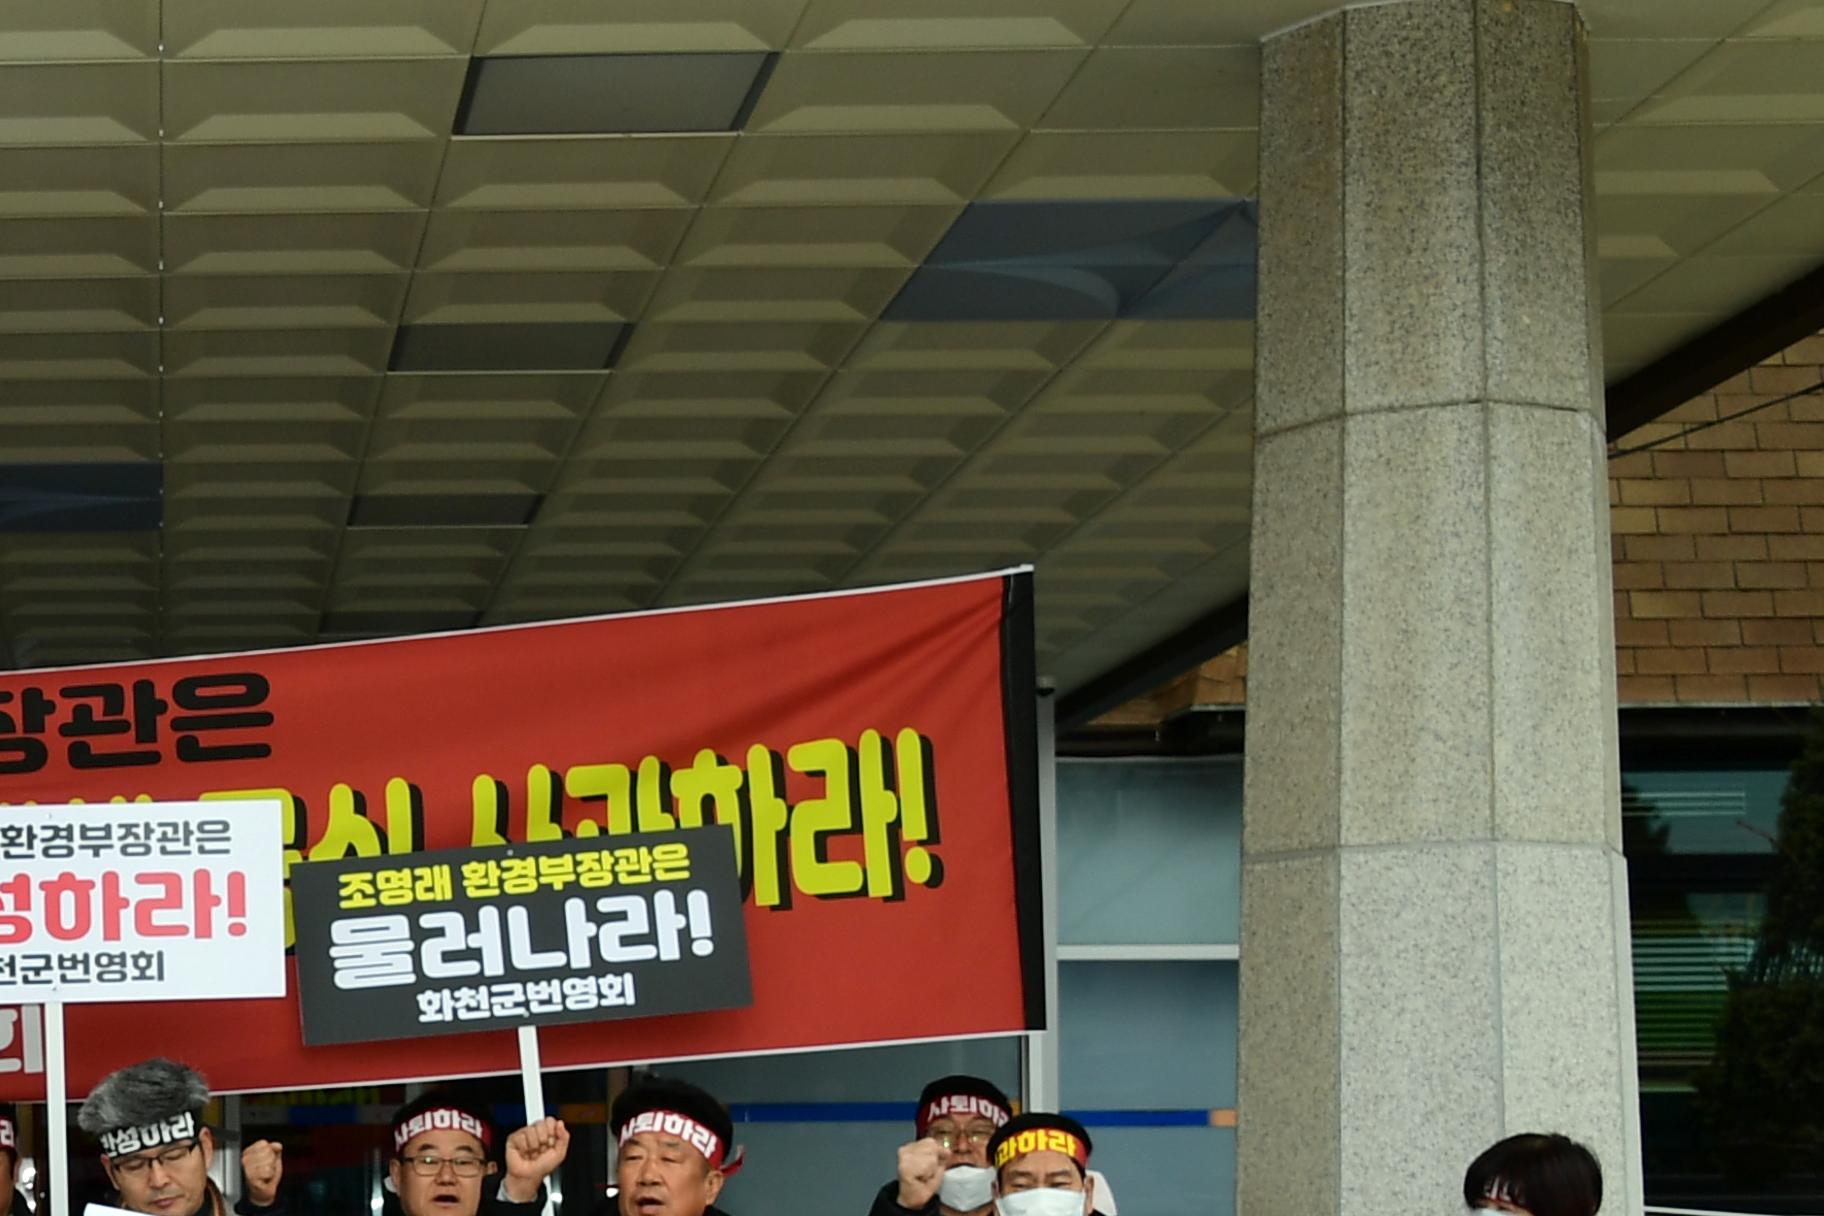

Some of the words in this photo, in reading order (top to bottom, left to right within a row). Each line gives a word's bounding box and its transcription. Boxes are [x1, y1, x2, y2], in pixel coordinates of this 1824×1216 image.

[0, 820, 232, 859] 환경부장관은
[340, 863, 452, 909] 조명래
[462, 843, 691, 899] 환경부장관은
[328, 889, 714, 991] 물러나라!
[417, 972, 637, 1023] 화천군번영회
[620, 1112, 717, 1159] 사퇴하라
